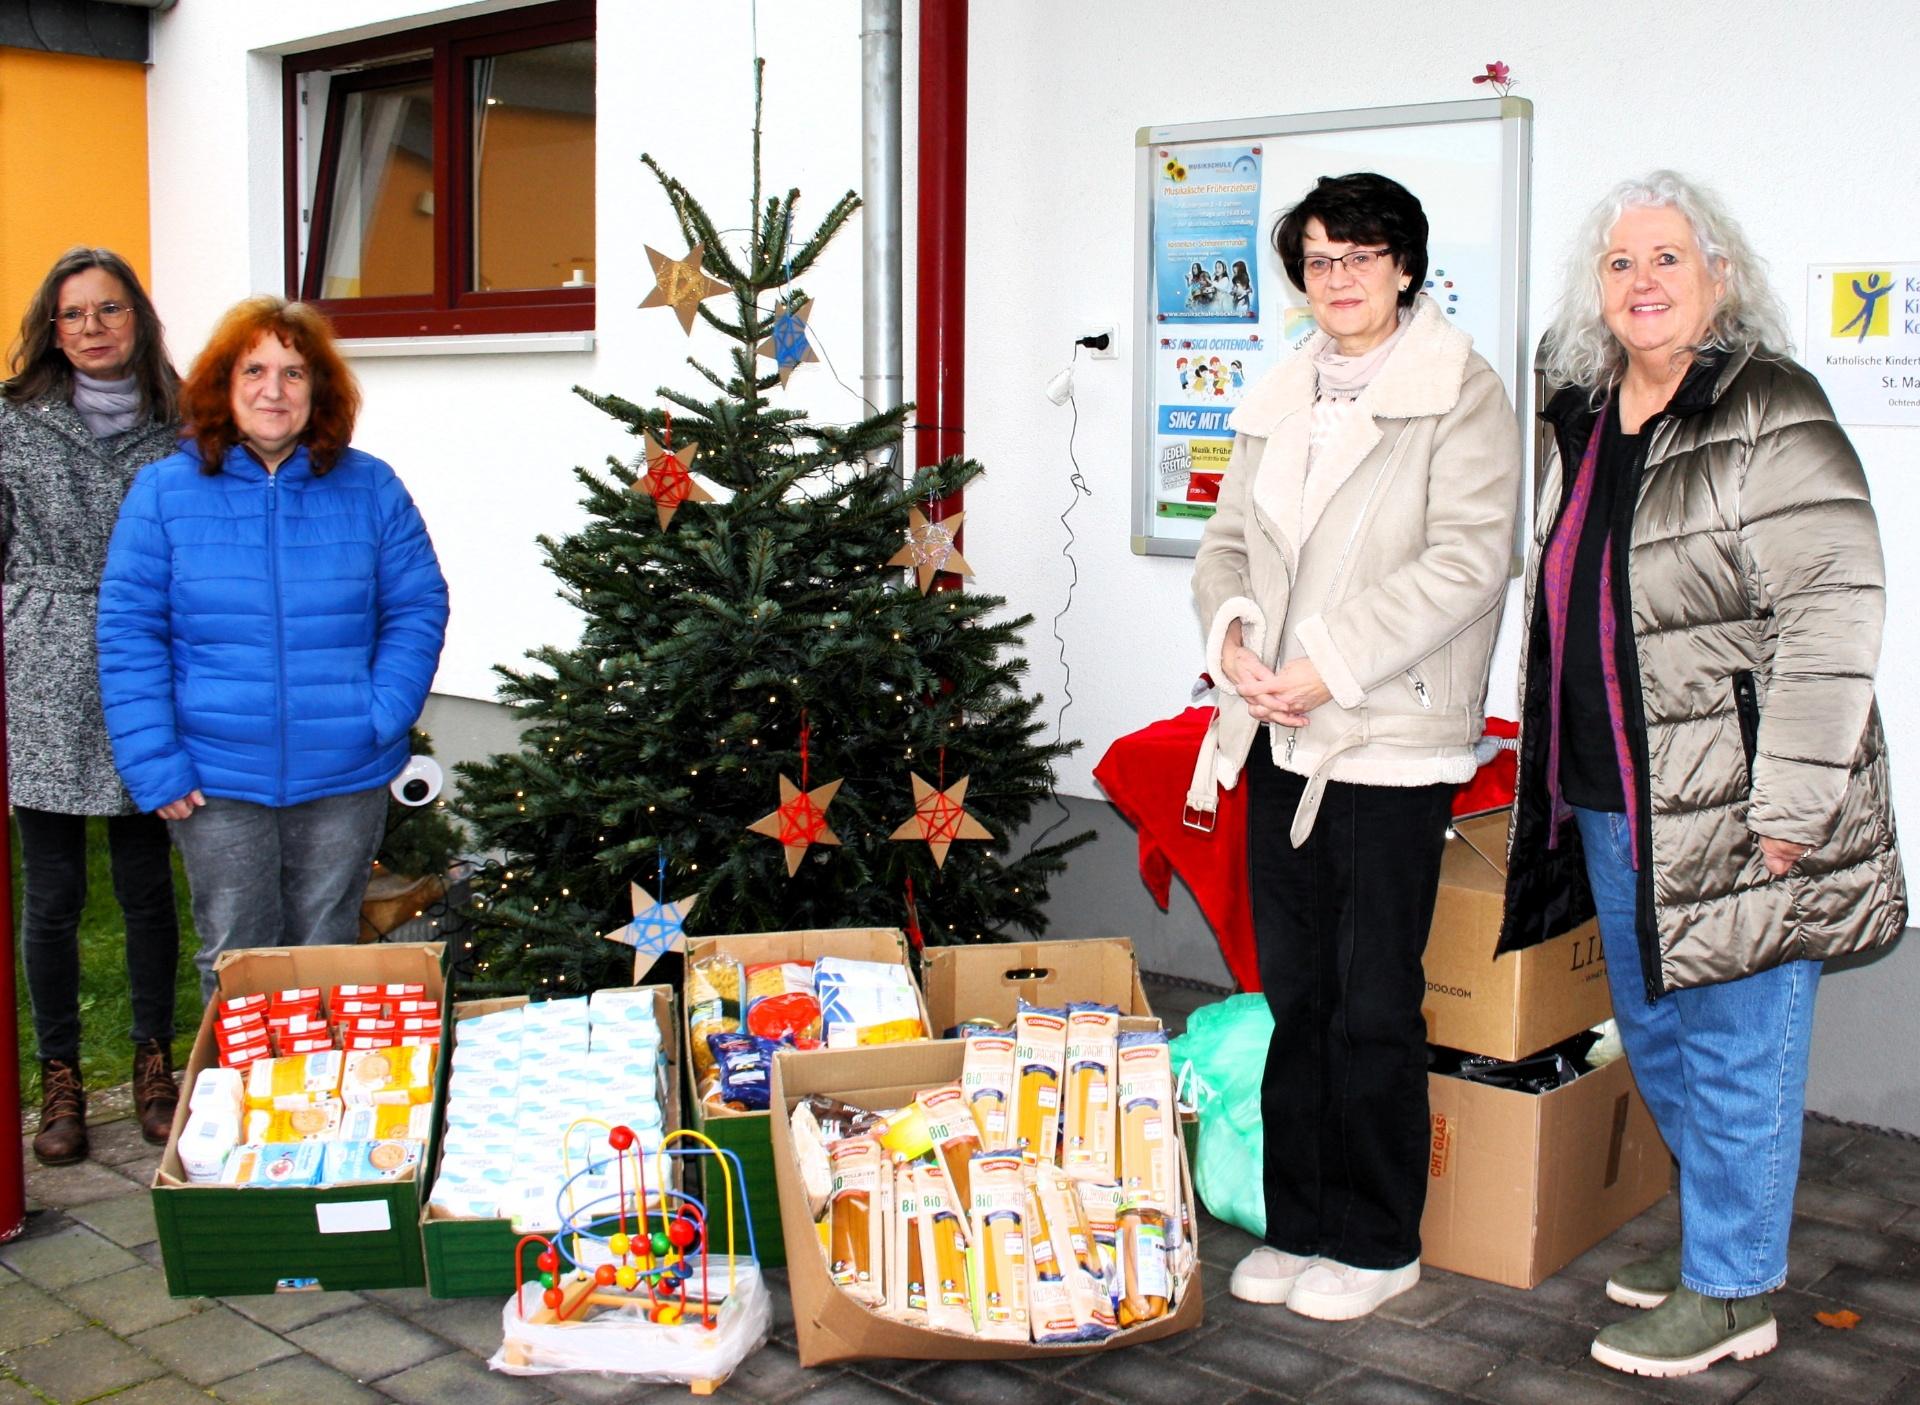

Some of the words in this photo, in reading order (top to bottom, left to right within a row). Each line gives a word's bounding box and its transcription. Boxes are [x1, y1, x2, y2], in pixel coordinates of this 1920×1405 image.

[1178, 339, 1207, 350] MSICA
[1210, 338, 1264, 351] OCHTENDUNG
[1826, 355, 1882, 365] Katholische
[1882, 376, 1898, 388] St.
[1169, 411, 1197, 430] SING
[1198, 412, 1222, 430] MIT
[1222, 413, 1233, 431] U
[1163, 444, 1185, 461] JEDEN
[1161, 456, 1191, 473] FREITAG
[1426, 982, 1472, 999] DOO.COM
[1028, 1019, 1061, 1030] COMBINO
[1430, 1152, 1443, 1177] CHT
